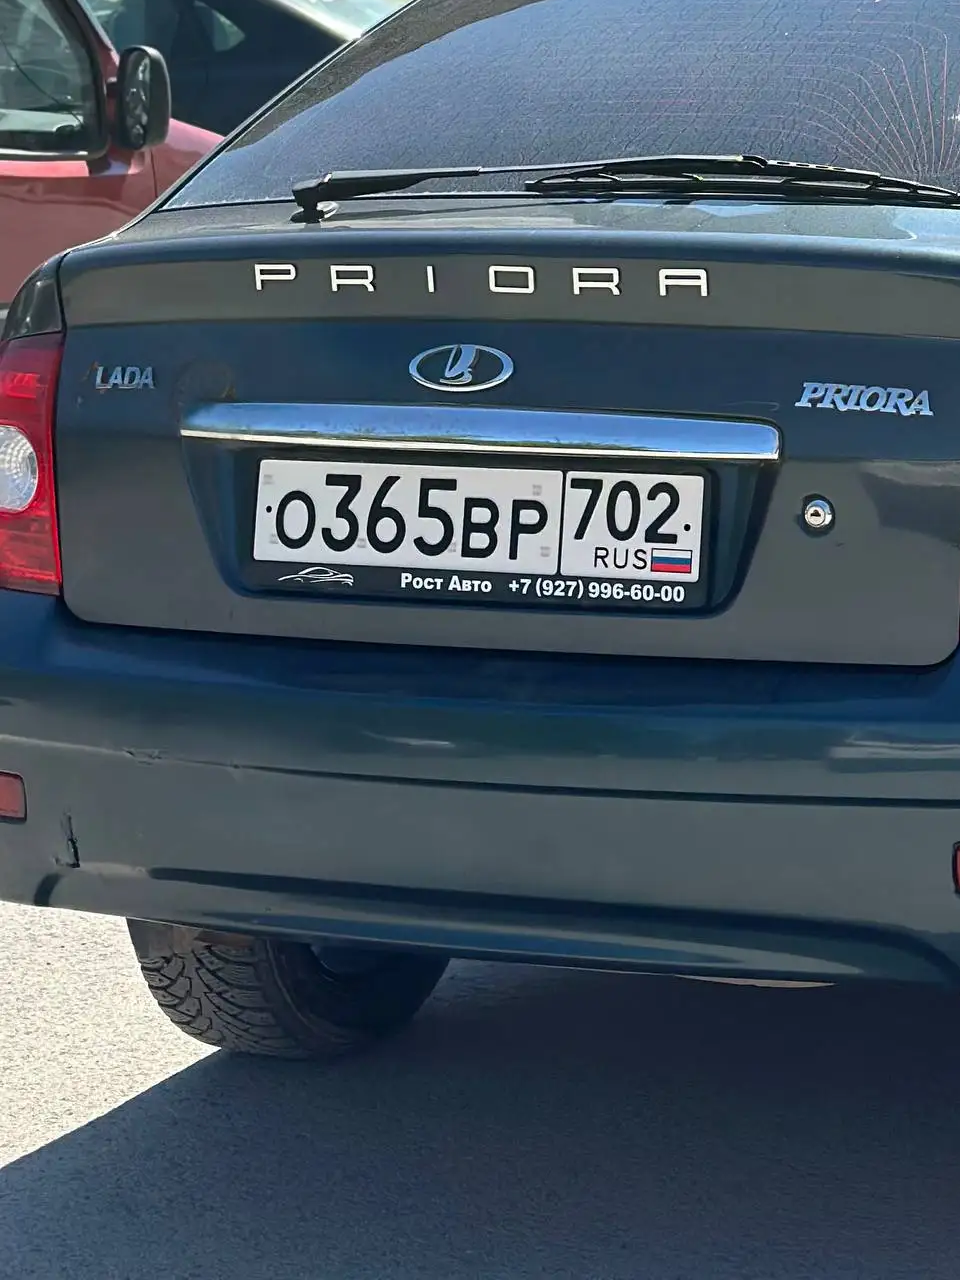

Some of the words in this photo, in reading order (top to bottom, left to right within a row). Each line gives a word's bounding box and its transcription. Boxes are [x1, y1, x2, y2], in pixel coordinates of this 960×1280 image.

[254, 263, 709, 297] PRIORA
[95, 365, 156, 390] LADA
[794, 381, 934, 417] PRIORA
[570, 478, 680, 544] 702
[593, 546, 648, 570] RUS
[508, 578, 532, 596] +7
[535, 578, 585, 599] (927)
[588, 581, 686, 603] 996-60-00
